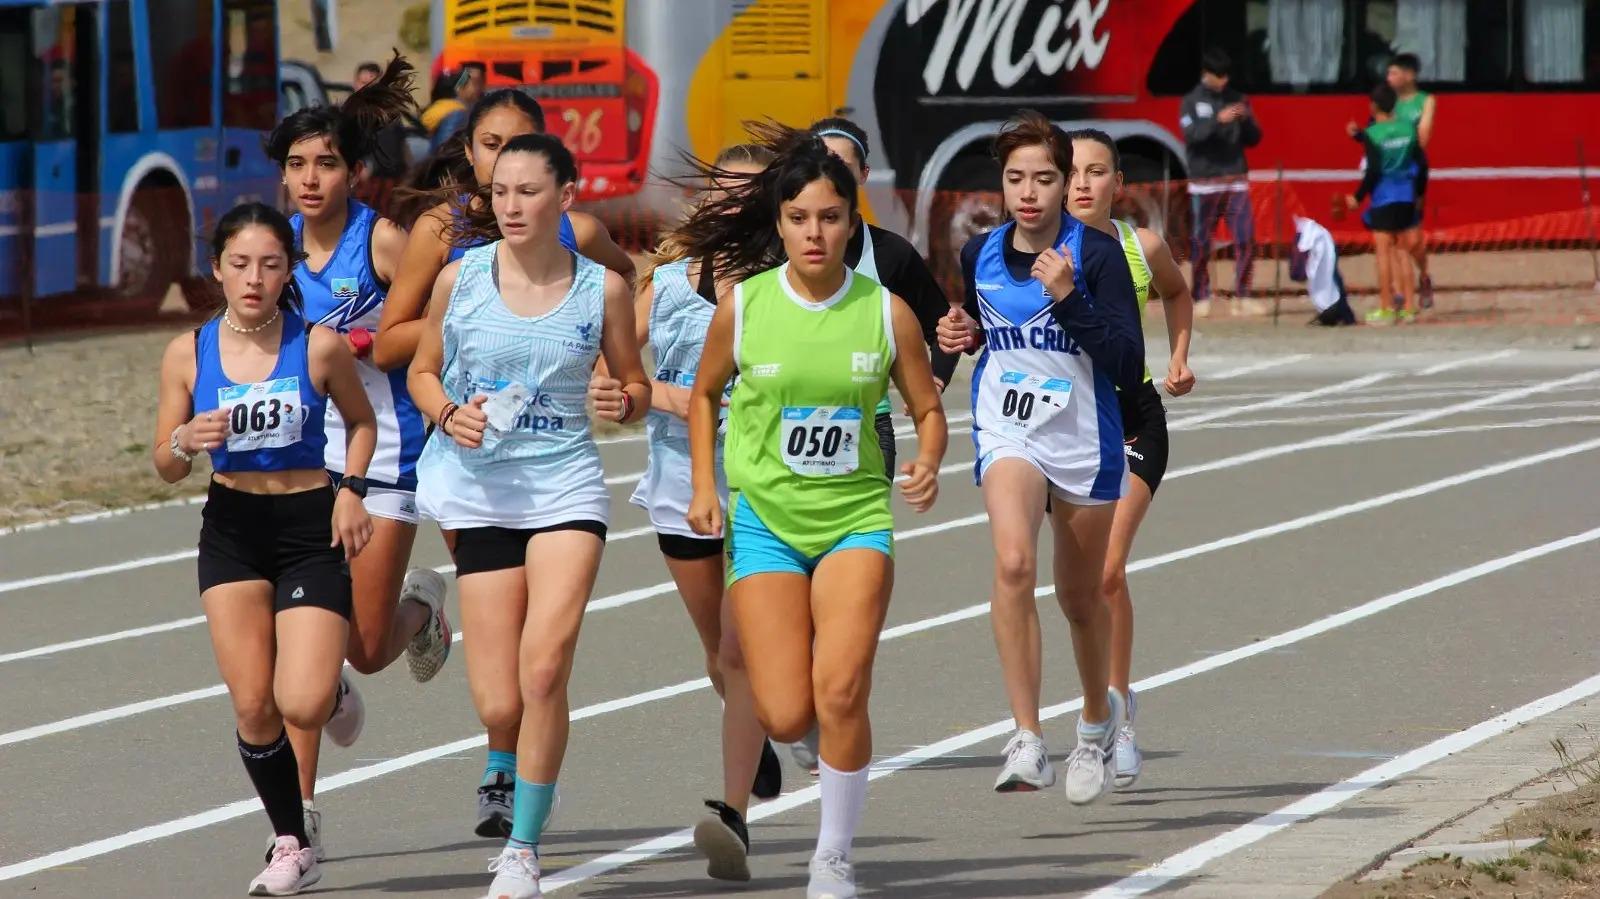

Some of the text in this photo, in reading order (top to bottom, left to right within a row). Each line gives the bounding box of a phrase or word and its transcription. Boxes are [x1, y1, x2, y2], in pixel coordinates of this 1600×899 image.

[906, 0, 1110, 95] Mix
[563, 108, 603, 153] 26
[232, 398, 281, 434] 063
[1002, 388, 1052, 420] 00
[787, 425, 842, 457] 050
